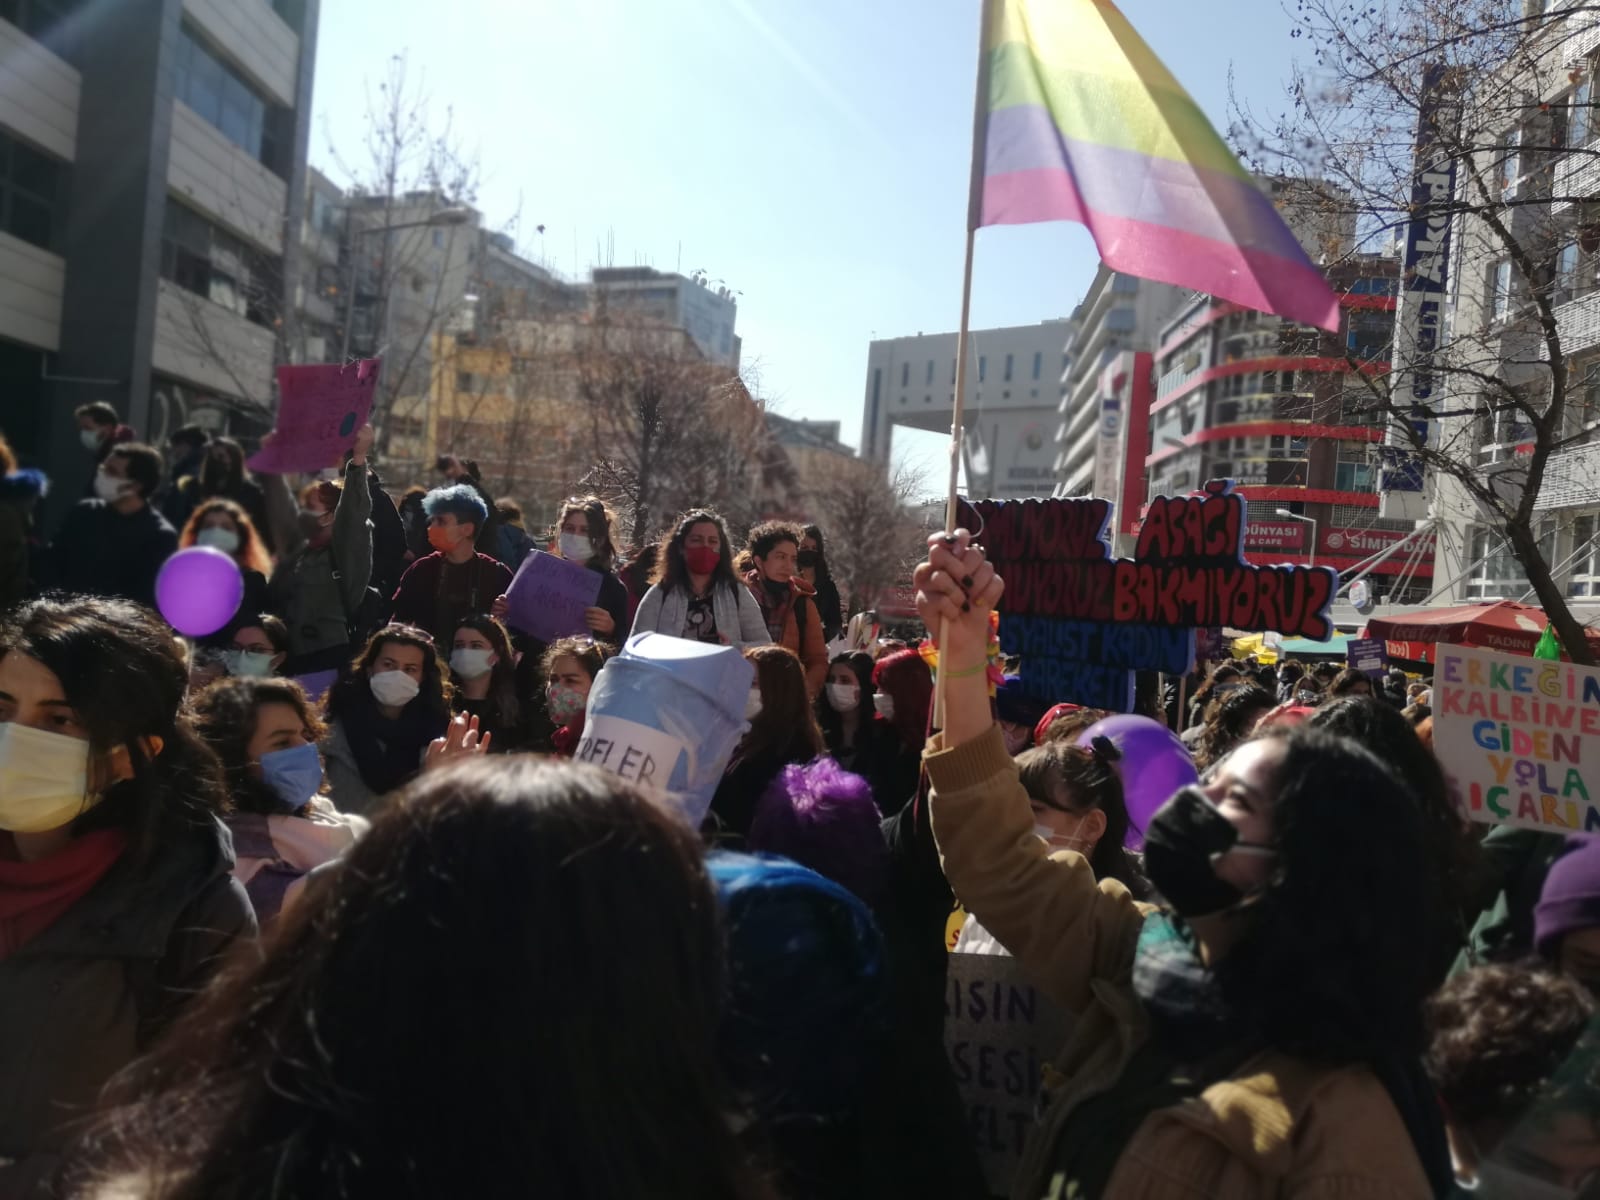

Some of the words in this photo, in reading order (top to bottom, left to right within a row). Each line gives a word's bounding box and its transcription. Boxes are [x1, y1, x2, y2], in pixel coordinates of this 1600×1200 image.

[1114, 560, 1330, 642] BAKMIYORUZ
[1440, 686, 1600, 736] KALBİNE
[1472, 720, 1581, 765] GİDEN
[1487, 754, 1591, 801] YOLA
[944, 977, 1040, 1025] IŞIN
